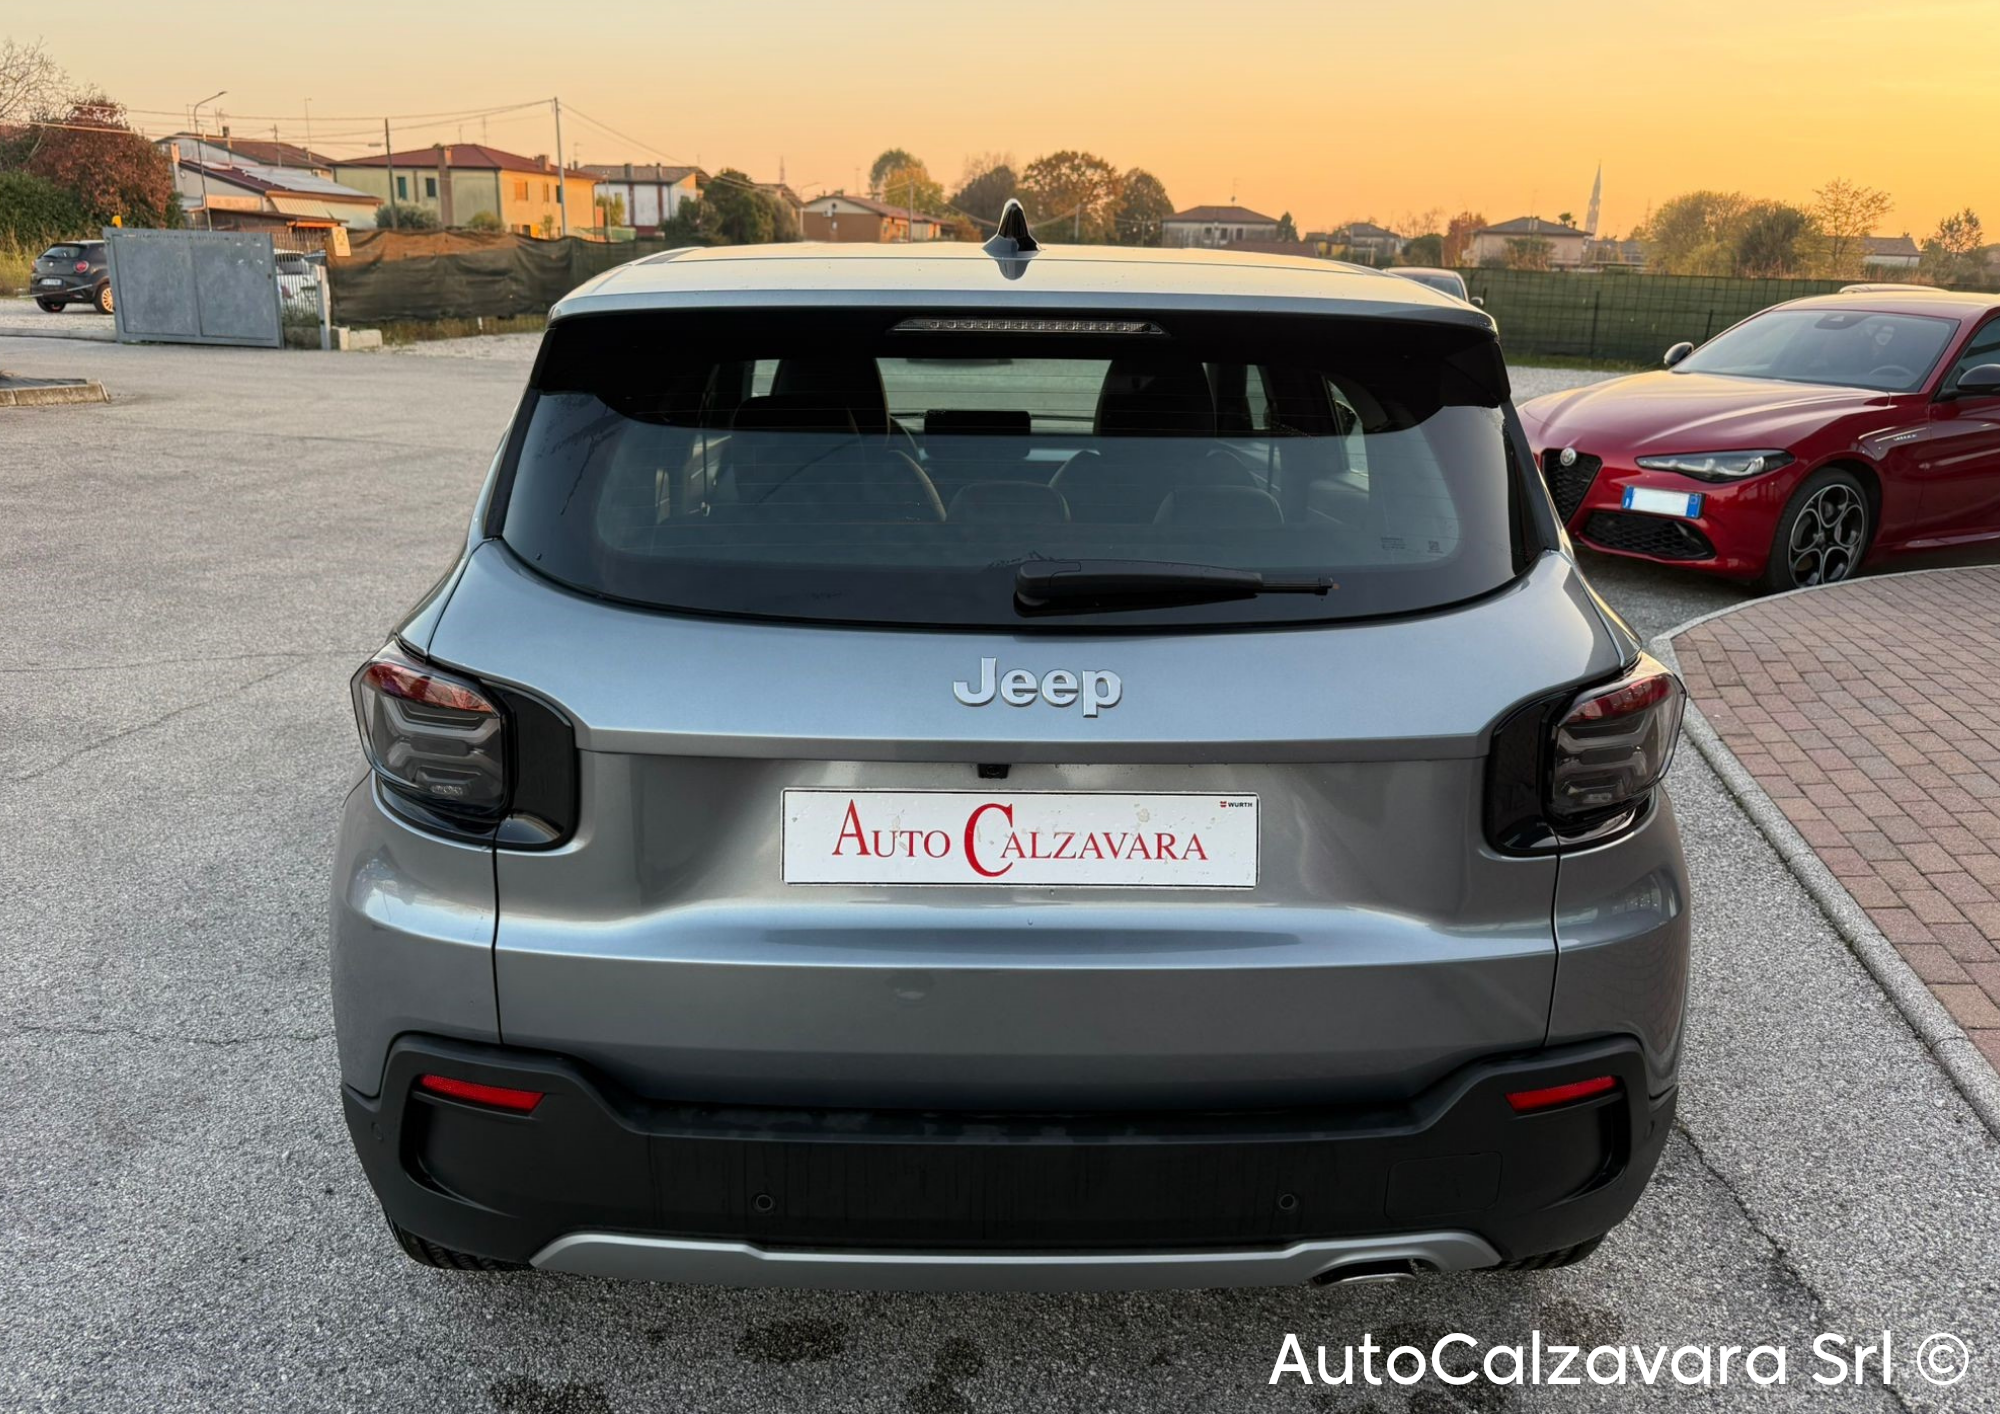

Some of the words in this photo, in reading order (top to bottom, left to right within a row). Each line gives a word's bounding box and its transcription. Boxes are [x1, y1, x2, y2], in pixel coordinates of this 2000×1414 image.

[953, 656, 1122, 718] Jeep
[832, 799, 950, 858] AUTO
[964, 803, 1208, 877] CALZAVARA
